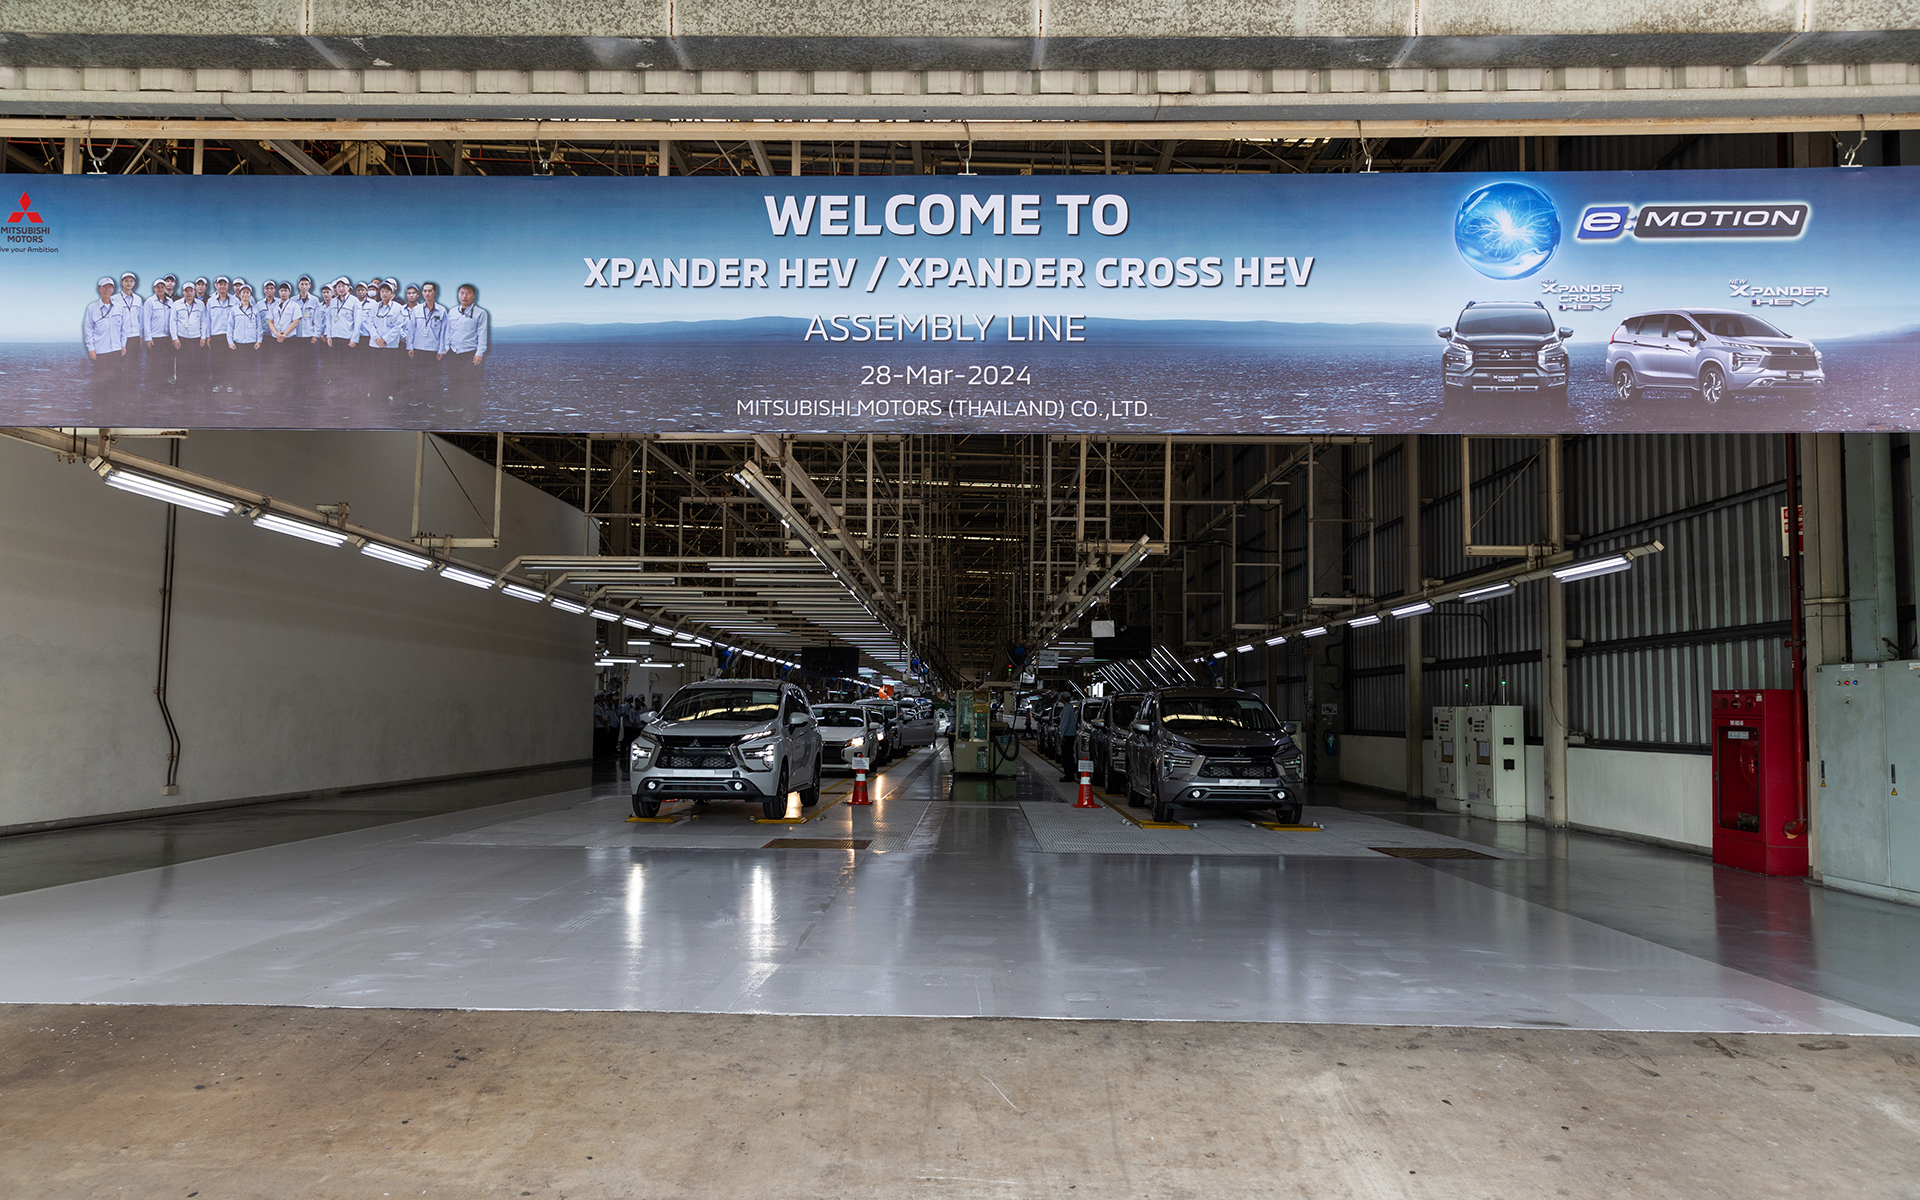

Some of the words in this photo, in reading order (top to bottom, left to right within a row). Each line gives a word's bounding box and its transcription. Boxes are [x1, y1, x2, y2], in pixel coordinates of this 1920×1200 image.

[763, 194, 1042, 237] WELCOME
[1056, 194, 1130, 237] TO
[0, 226, 50, 234] MITSUBISHI
[7, 235, 44, 243] MOTORS
[583, 257, 769, 289] XPANDER
[778, 257, 858, 289] HEV
[864, 255, 889, 293] /
[897, 257, 1086, 289] XPANDER
[1094, 257, 1223, 288] CROSS
[1233, 256, 1315, 288] HEV
[1541, 282, 1624, 295] XPANDER
[1729, 283, 1830, 298] XPANDER
[1558, 293, 1613, 304] CROSS
[1751, 298, 1815, 307] HEV
[1559, 303, 1611, 311] HEV
[803, 313, 996, 342] ASSEMBLY
[1007, 313, 1087, 342] LINE
[860, 364, 1032, 386] 28-Mar-2024
[735, 399, 851, 417] MITSUBISHI
[856, 399, 943, 417] MOTORS
[948, 399, 1066, 419] (THAILAND)
[1070, 399, 1154, 420] CO.,LTD.
